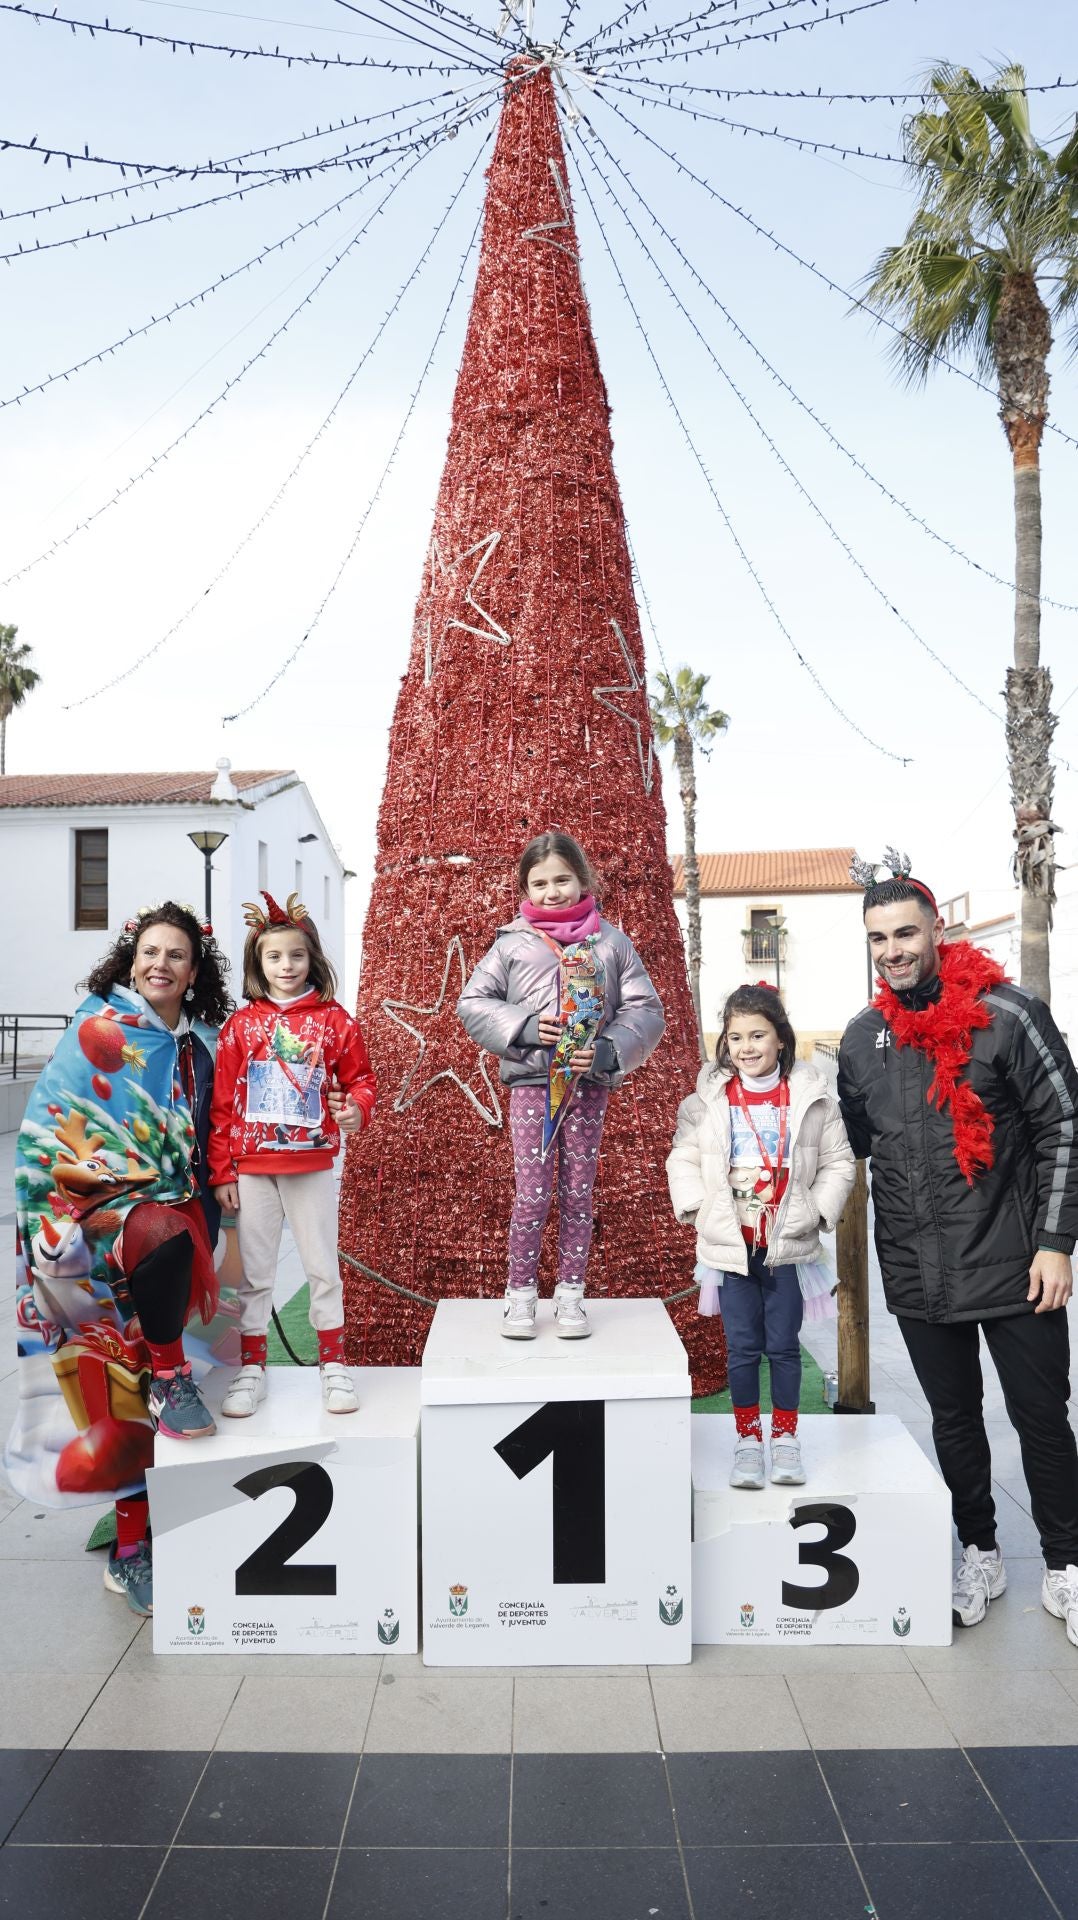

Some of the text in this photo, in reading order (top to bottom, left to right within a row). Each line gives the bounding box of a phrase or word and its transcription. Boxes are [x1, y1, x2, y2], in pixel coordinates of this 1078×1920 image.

[494, 1400, 605, 1584] 1
[233, 1462, 336, 1595] 2
[782, 1504, 859, 1610] 3
[498, 1601, 545, 1610] CONCEJALÍA
[232, 1622, 274, 1630] CONCEJALÍA
[508, 1619, 547, 1628] JUVENTUD
[241, 1638, 276, 1646] JUVENTUD
